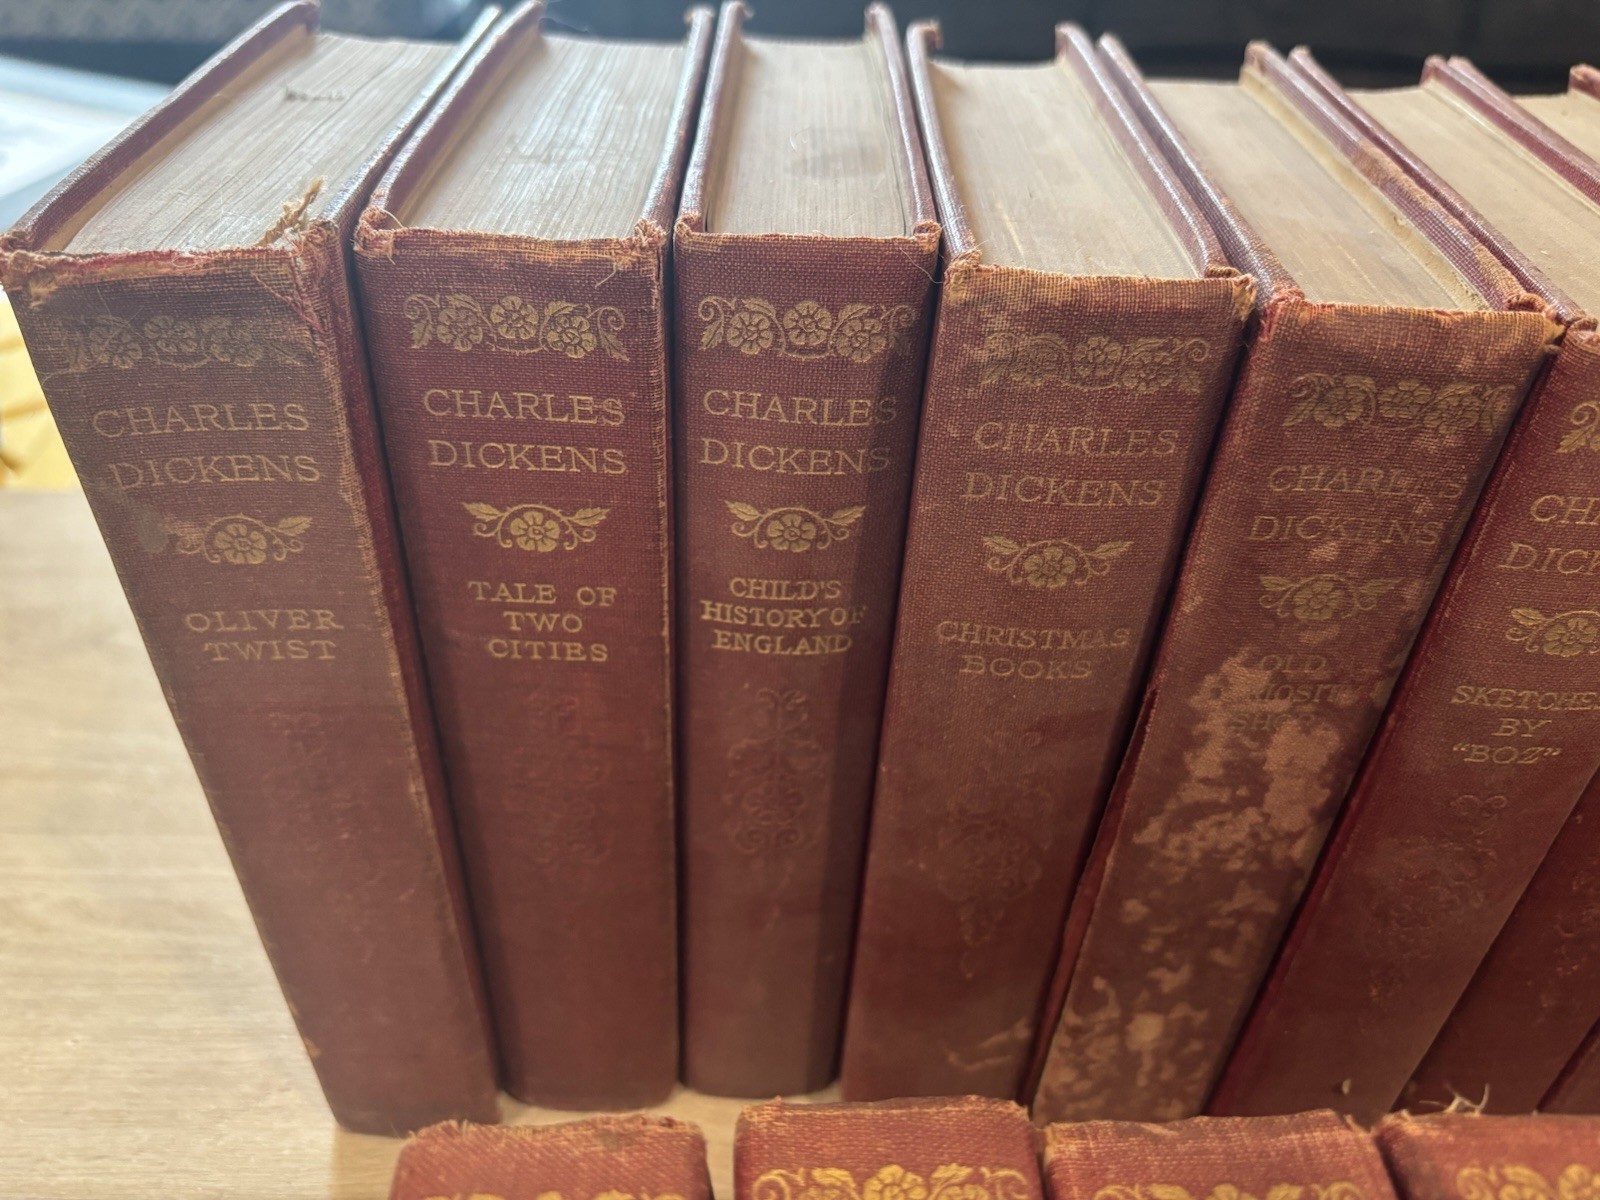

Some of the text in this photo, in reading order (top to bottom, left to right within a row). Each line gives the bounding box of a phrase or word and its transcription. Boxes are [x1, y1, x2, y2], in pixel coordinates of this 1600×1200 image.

[92, 404, 309, 437] CHARLES
[424, 389, 625, 426] CHARLES
[703, 389, 897, 426] CHARLES
[973, 421, 1179, 456] CHARLES
[428, 439, 627, 474] DICKENS
[701, 437, 890, 475] DICKENS
[108, 454, 320, 490] DICKENS
[961, 472, 1165, 506] DICKENS
[467, 581, 617, 606] TALE OF
[730, 577, 841, 601] CHILD'S
[185, 609, 344, 633] OLIVER
[503, 611, 583, 633] TWO
[700, 600, 867, 628] HISTORY OF
[712, 629, 852, 655] ENGLAND
[936, 620, 1131, 649] CHRISTMAS
[203, 639, 337, 661] TWIST
[488, 639, 608, 662] CITIES
[959, 655, 1092, 679] BOOKS
[1450, 685, 1600, 710] SKETCHE
[1491, 717, 1552, 737] BY
